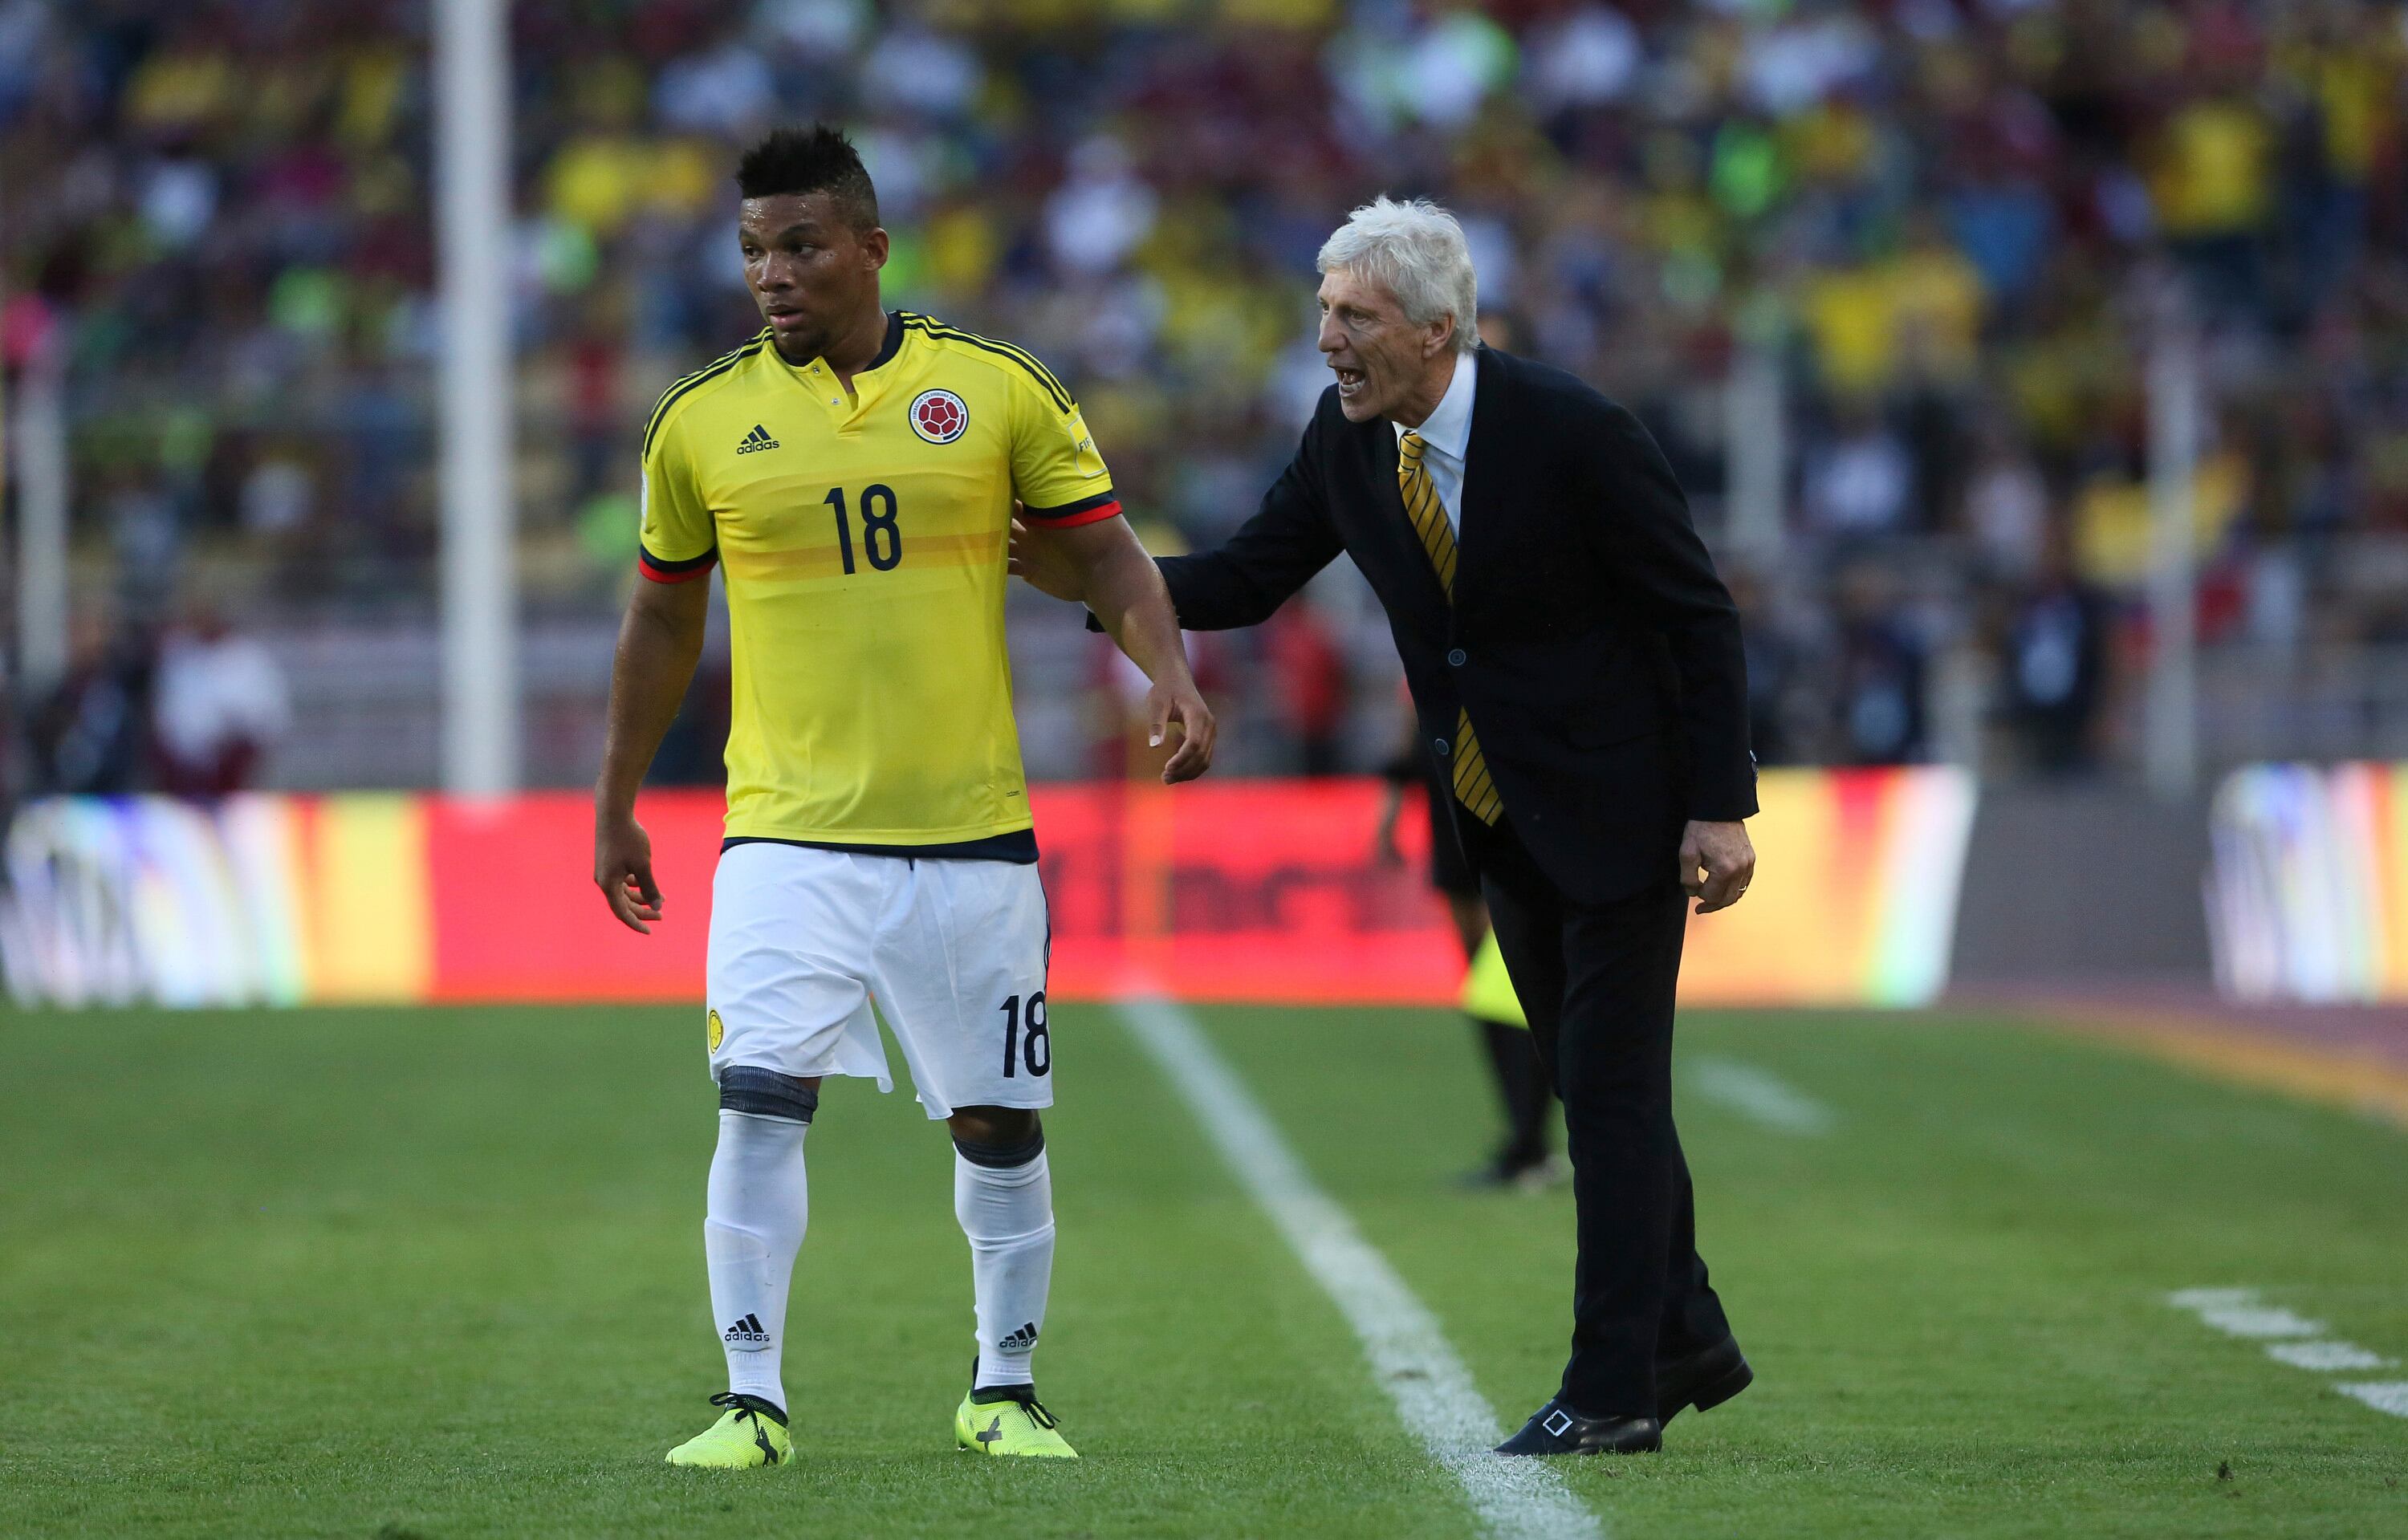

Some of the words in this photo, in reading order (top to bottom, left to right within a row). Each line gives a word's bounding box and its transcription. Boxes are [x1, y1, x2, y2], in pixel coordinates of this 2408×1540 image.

[737, 441, 780, 455] adidas
[1079, 437, 1092, 453] FIF
[823, 484, 902, 575] 18
[999, 990, 1051, 1079] 18
[724, 1331, 771, 1342] adidas
